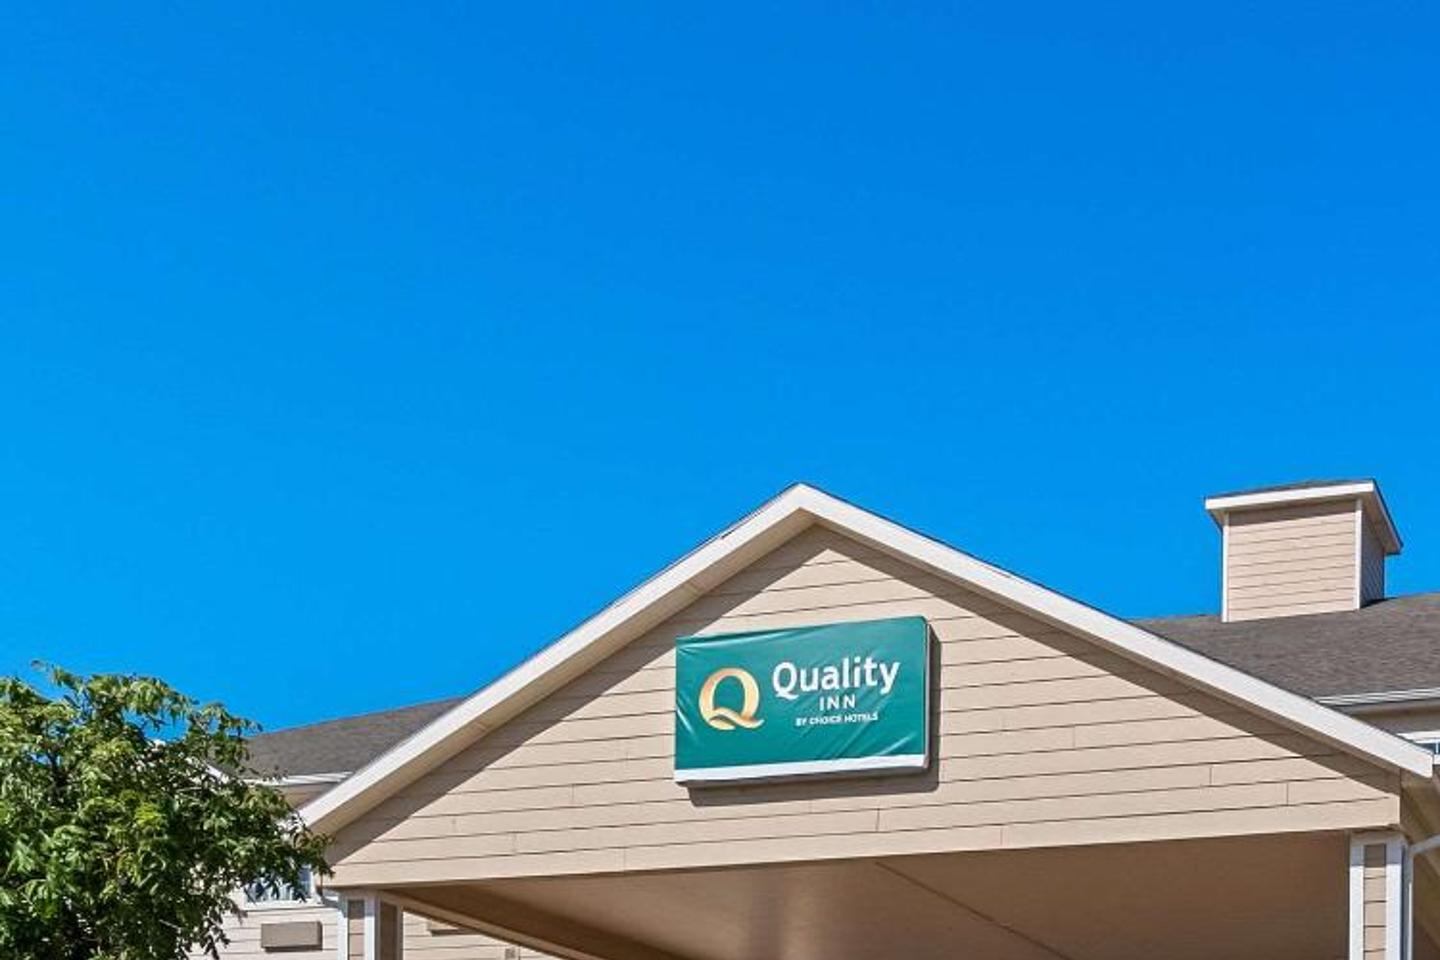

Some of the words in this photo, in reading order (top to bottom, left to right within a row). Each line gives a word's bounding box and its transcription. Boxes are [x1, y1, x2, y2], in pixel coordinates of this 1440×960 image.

[772, 656, 900, 700] Quality
[698, 667, 764, 730] Q
[819, 694, 856, 711] INN
[844, 712, 878, 724] HOTELS
